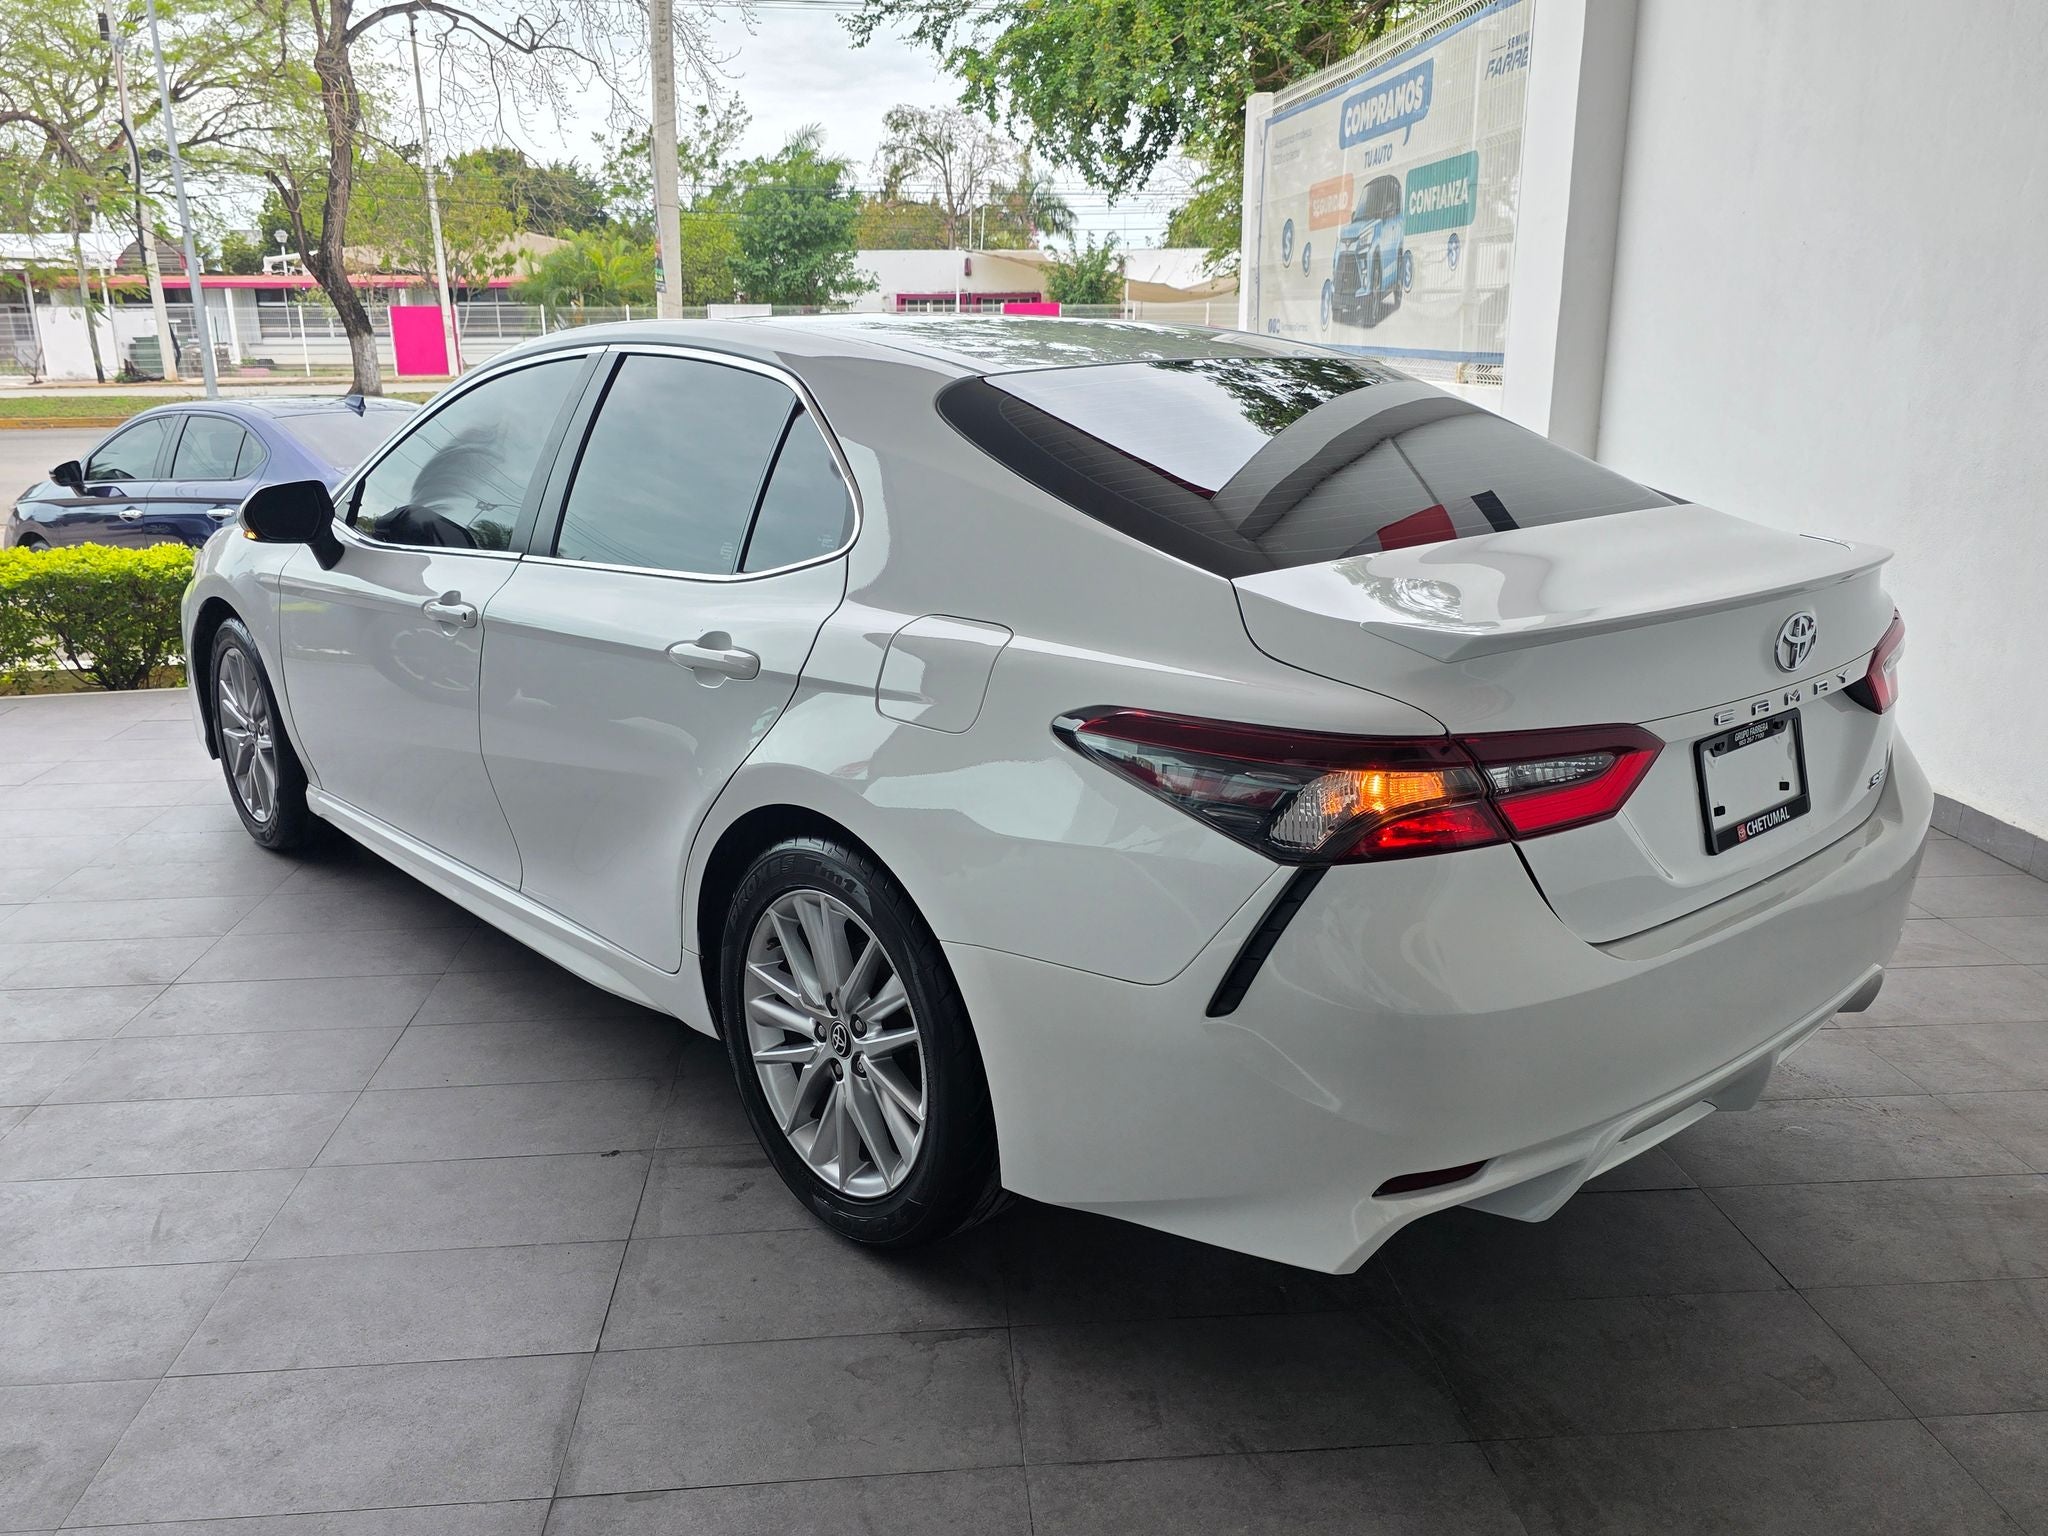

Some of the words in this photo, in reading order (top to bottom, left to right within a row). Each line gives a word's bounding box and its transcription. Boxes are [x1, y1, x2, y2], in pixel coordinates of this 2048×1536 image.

[1345, 75, 1424, 138] COMPRAMOS
[1364, 151, 1374, 169] TU
[1374, 143, 1393, 167] AUTO
[1409, 178, 1469, 215] CONFIANZA
[1713, 669, 1849, 726] CAMRY
[1868, 769, 1887, 790] SE
[1746, 806, 1790, 836] CHETUMAL
